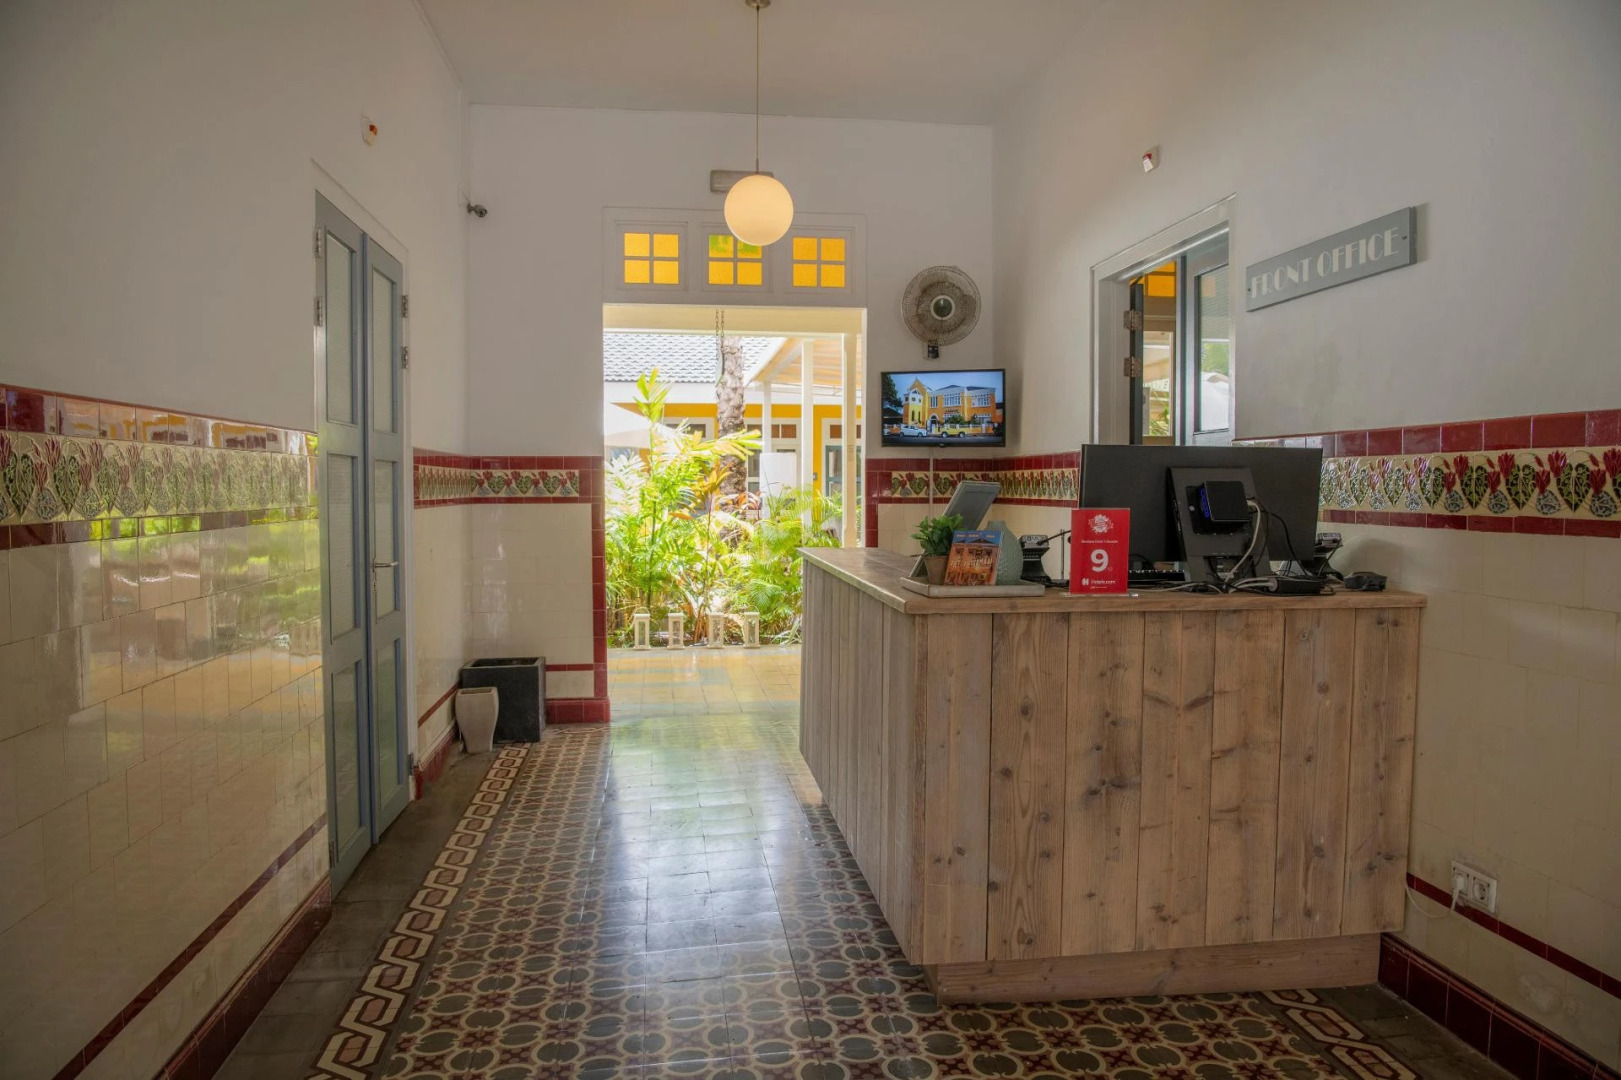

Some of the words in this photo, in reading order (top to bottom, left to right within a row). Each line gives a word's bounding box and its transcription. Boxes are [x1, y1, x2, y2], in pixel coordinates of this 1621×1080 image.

[1251, 257, 1313, 299] FRONT
[1317, 227, 1399, 277] OFFICE
[1090, 549, 1109, 572] 9
